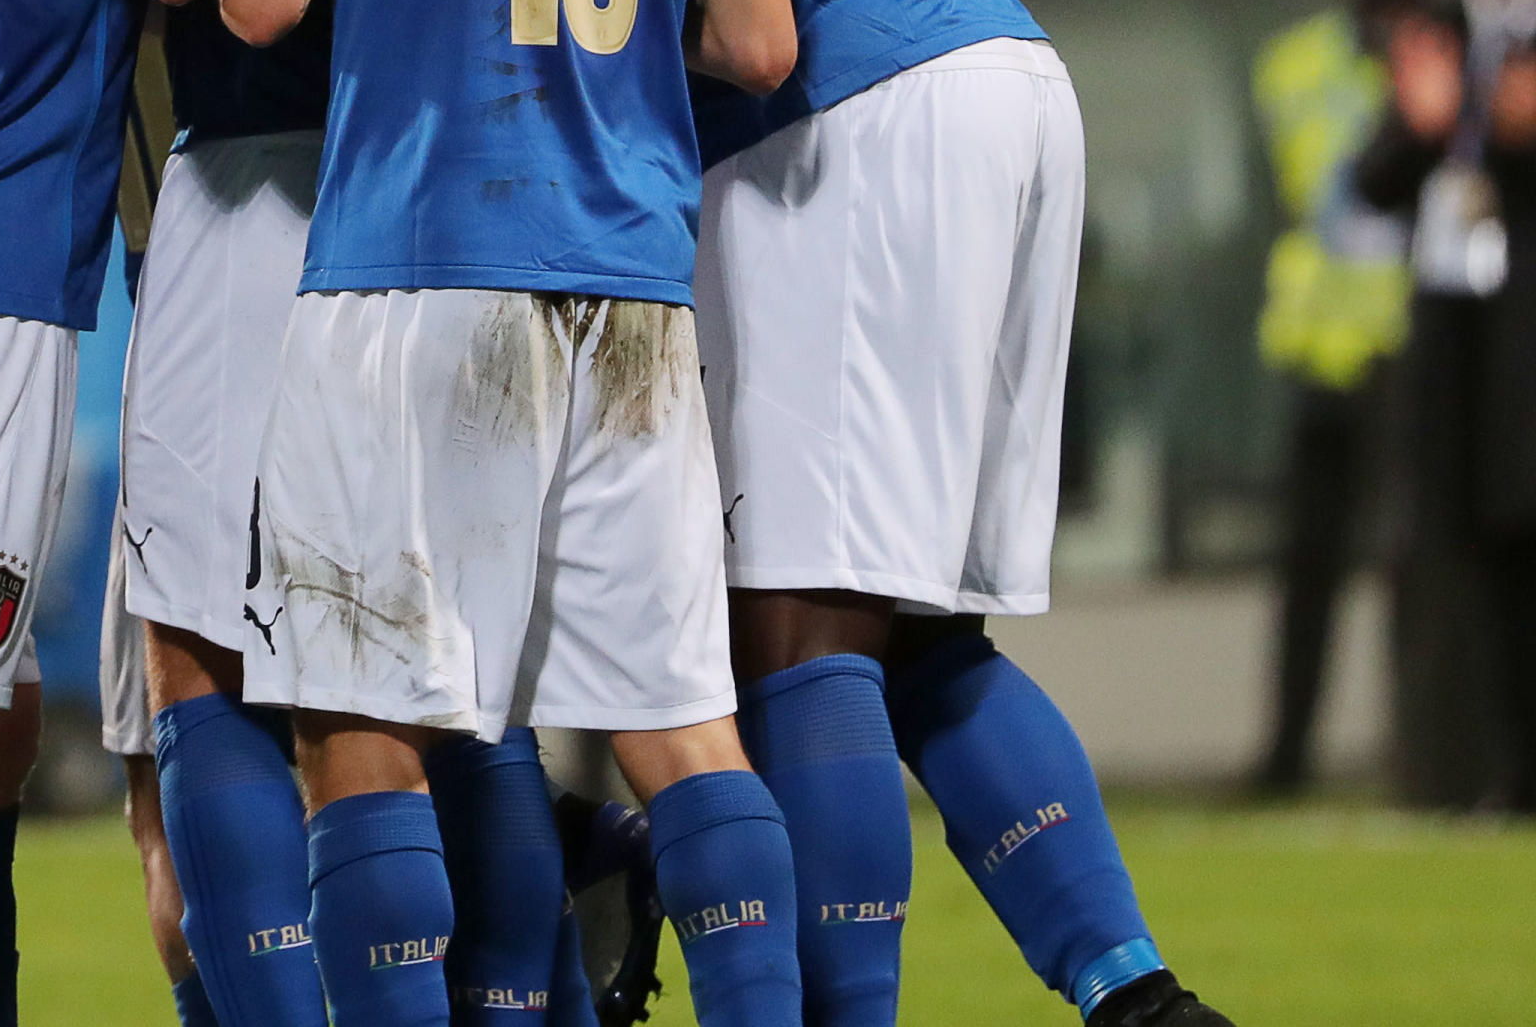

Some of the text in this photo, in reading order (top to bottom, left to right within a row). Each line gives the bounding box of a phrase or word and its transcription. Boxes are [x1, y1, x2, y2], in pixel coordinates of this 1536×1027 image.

[984, 802, 1068, 874] ITALIA
[677, 899, 766, 939] ITALIA
[248, 923, 311, 952] ITAL
[369, 936, 449, 966] ITALIA
